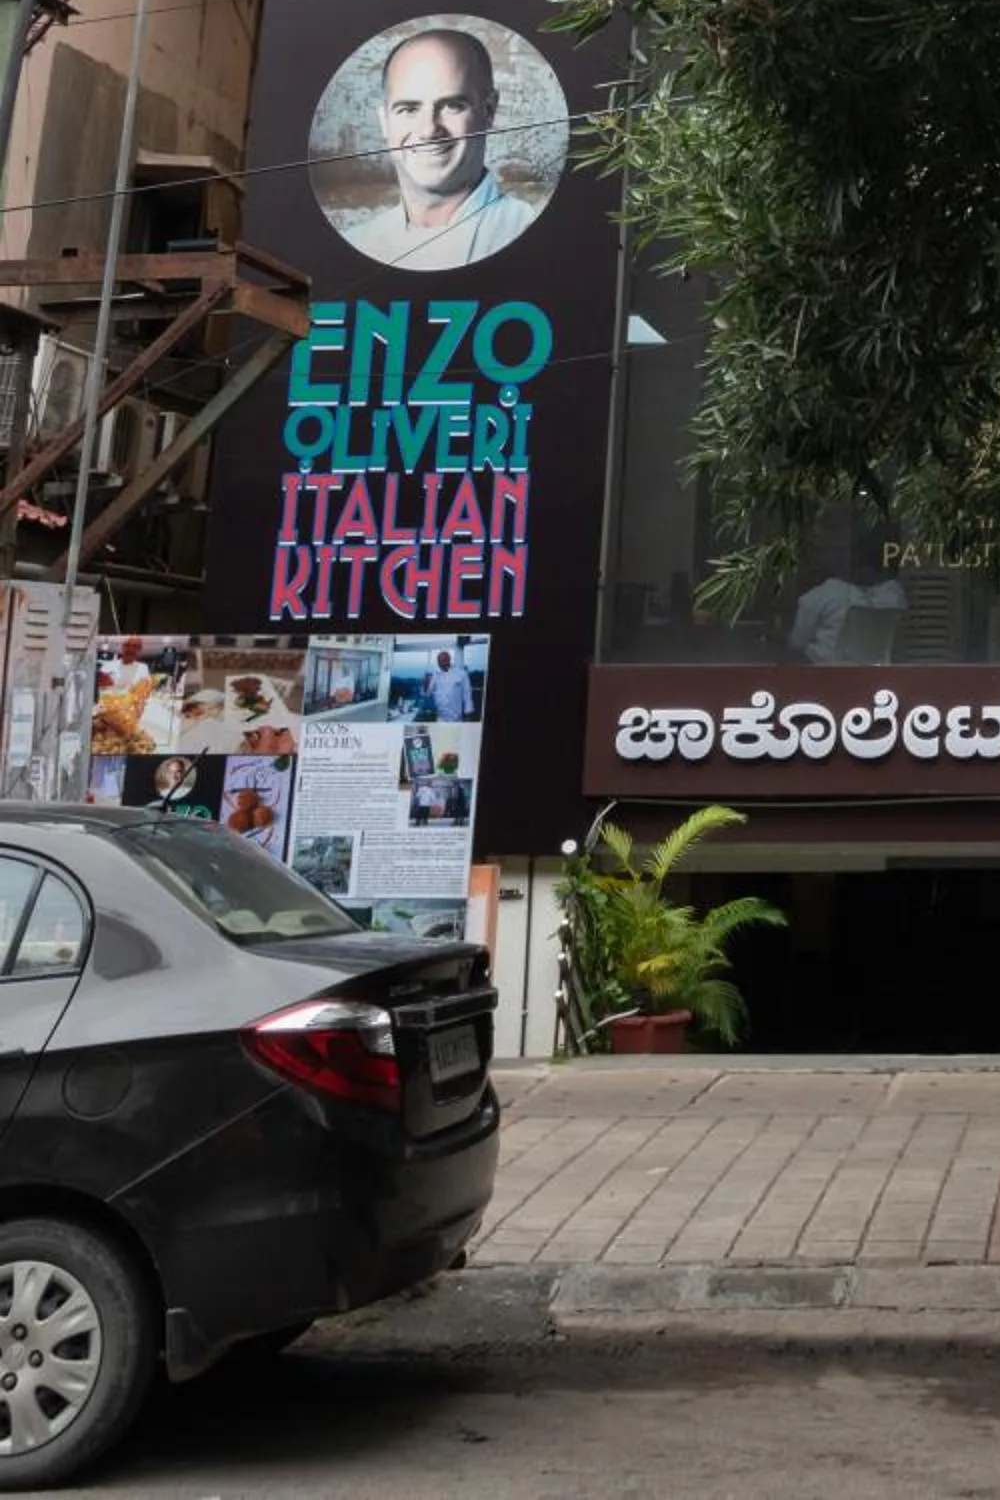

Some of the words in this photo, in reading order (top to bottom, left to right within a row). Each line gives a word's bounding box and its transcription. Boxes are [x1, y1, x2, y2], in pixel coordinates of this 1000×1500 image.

[288, 299, 554, 407] ENZO
[281, 403, 533, 475] OLIVERI
[278, 472, 530, 545] ITALIAN
[270, 543, 529, 620] KITCHEN
